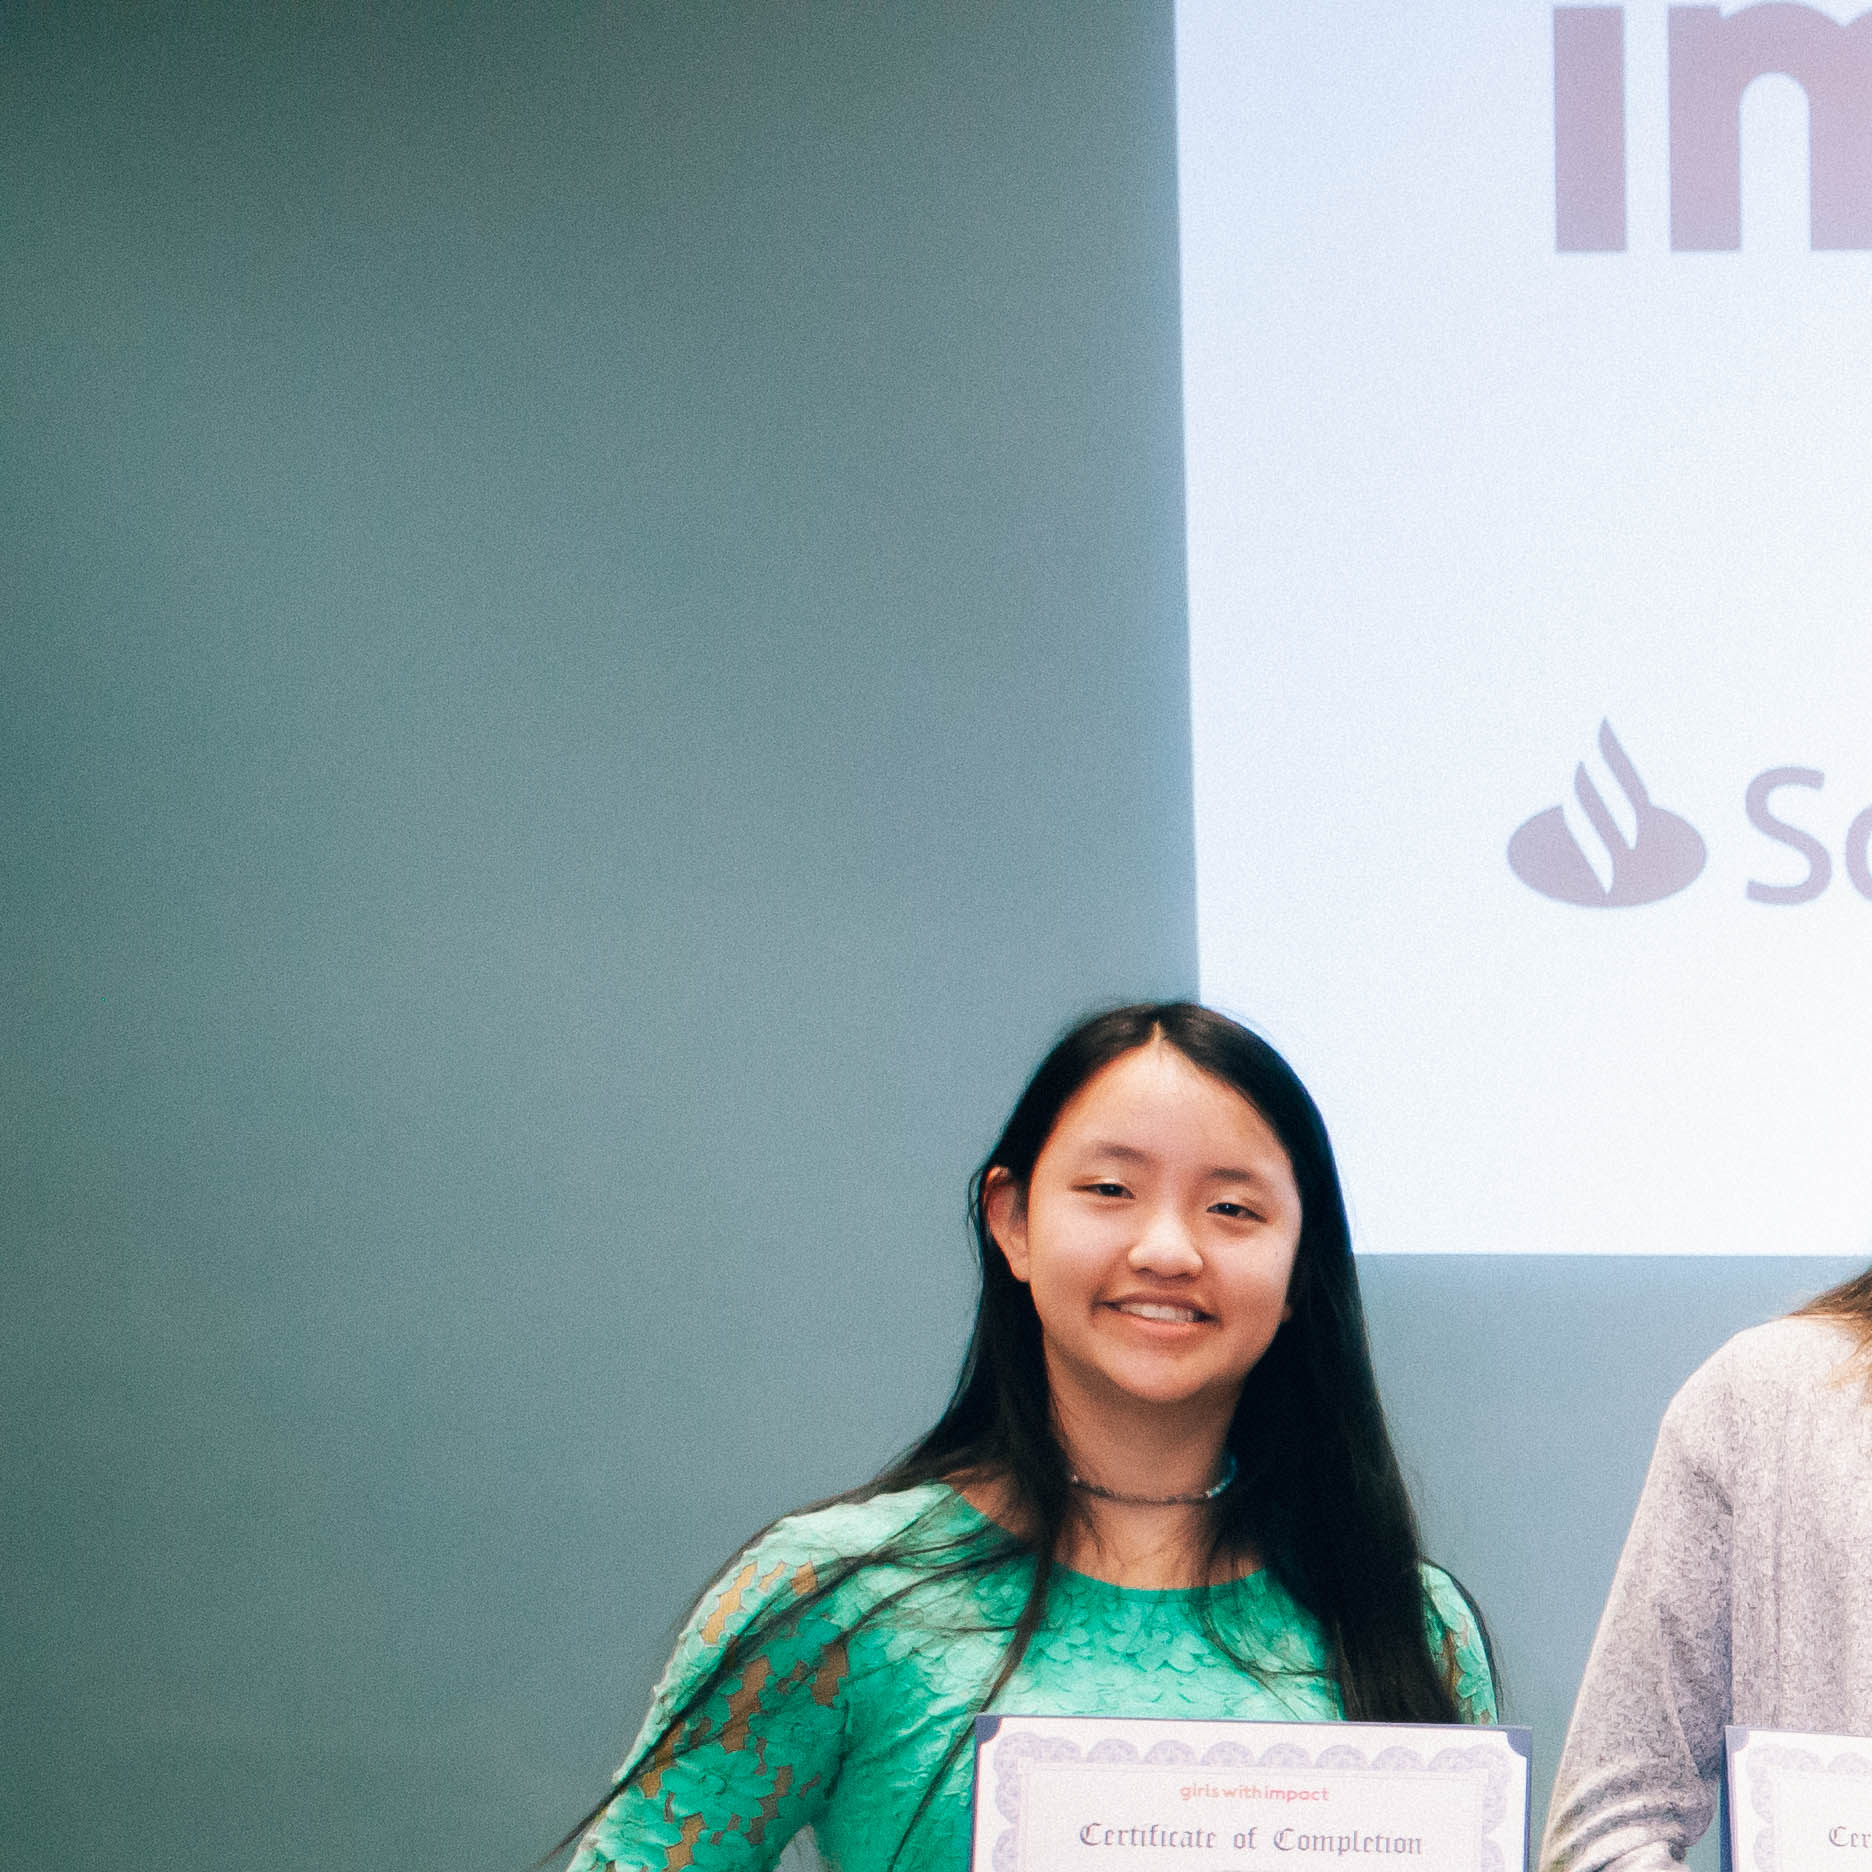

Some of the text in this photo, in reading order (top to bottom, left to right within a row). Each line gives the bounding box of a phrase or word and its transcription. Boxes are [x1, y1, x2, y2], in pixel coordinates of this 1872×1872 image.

[1079, 1822, 1423, 1857] Certificate of Completion
